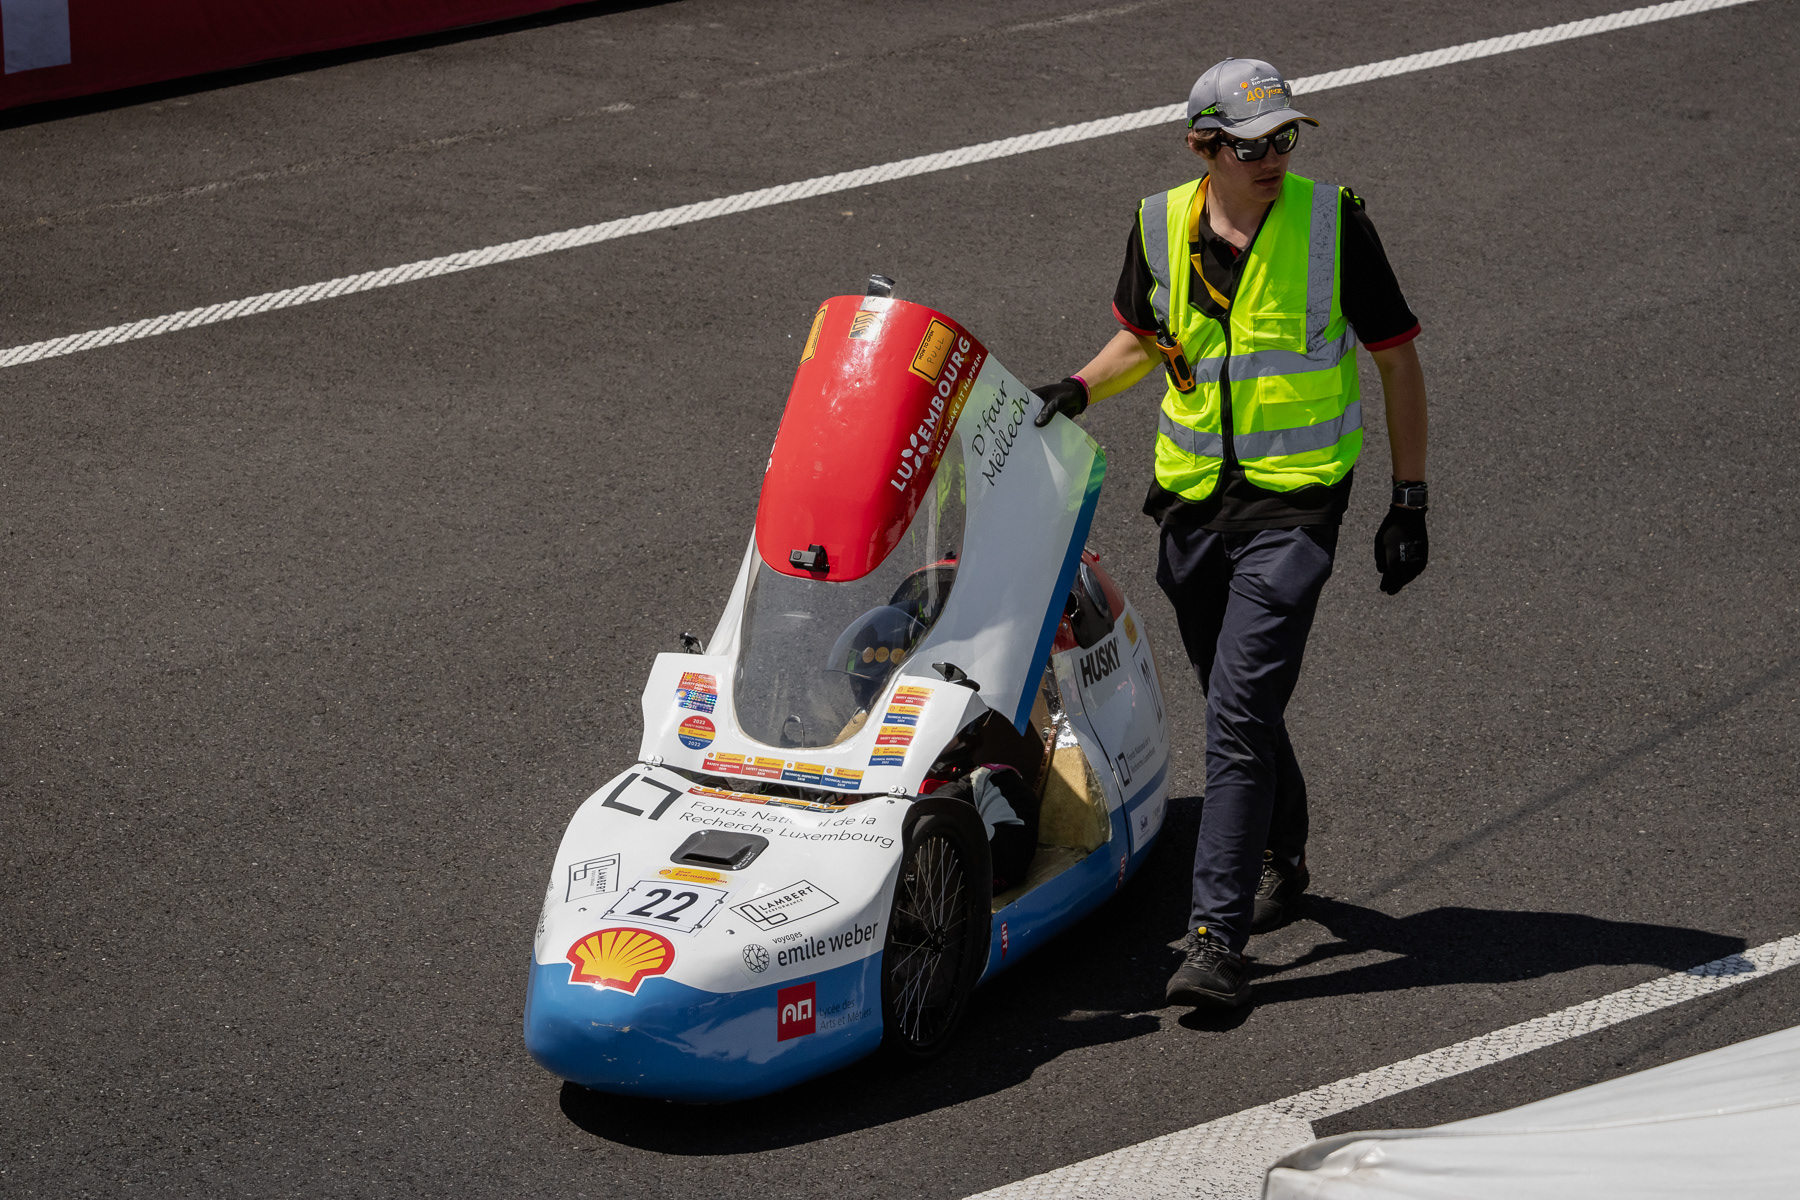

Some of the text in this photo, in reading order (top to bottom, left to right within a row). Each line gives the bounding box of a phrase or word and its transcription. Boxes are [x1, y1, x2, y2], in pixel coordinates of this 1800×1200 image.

[1246, 87, 1265, 102] 40
[918, 330, 935, 360] HOW TO OPEN
[927, 337, 945, 365] PULL
[936, 353, 982, 455] LET'S MAKE IT HAPPEN
[971, 380, 1007, 456] D'fair
[982, 391, 1030, 487] Mëllech
[1080, 636, 1121, 688] HUSKY
[690, 800, 877, 828] Fonds Natil de la
[679, 811, 895, 849] Recherche Luxembourg
[675, 872, 728, 885] Eco-marathon
[626, 888, 699, 923] 22
[758, 886, 814, 911] LAMBERT
[772, 931, 803, 944] voyages
[777, 922, 879, 967] emile weber
[819, 999, 855, 1019] Lycée des
[820, 1007, 872, 1032] Arts et Métiers
